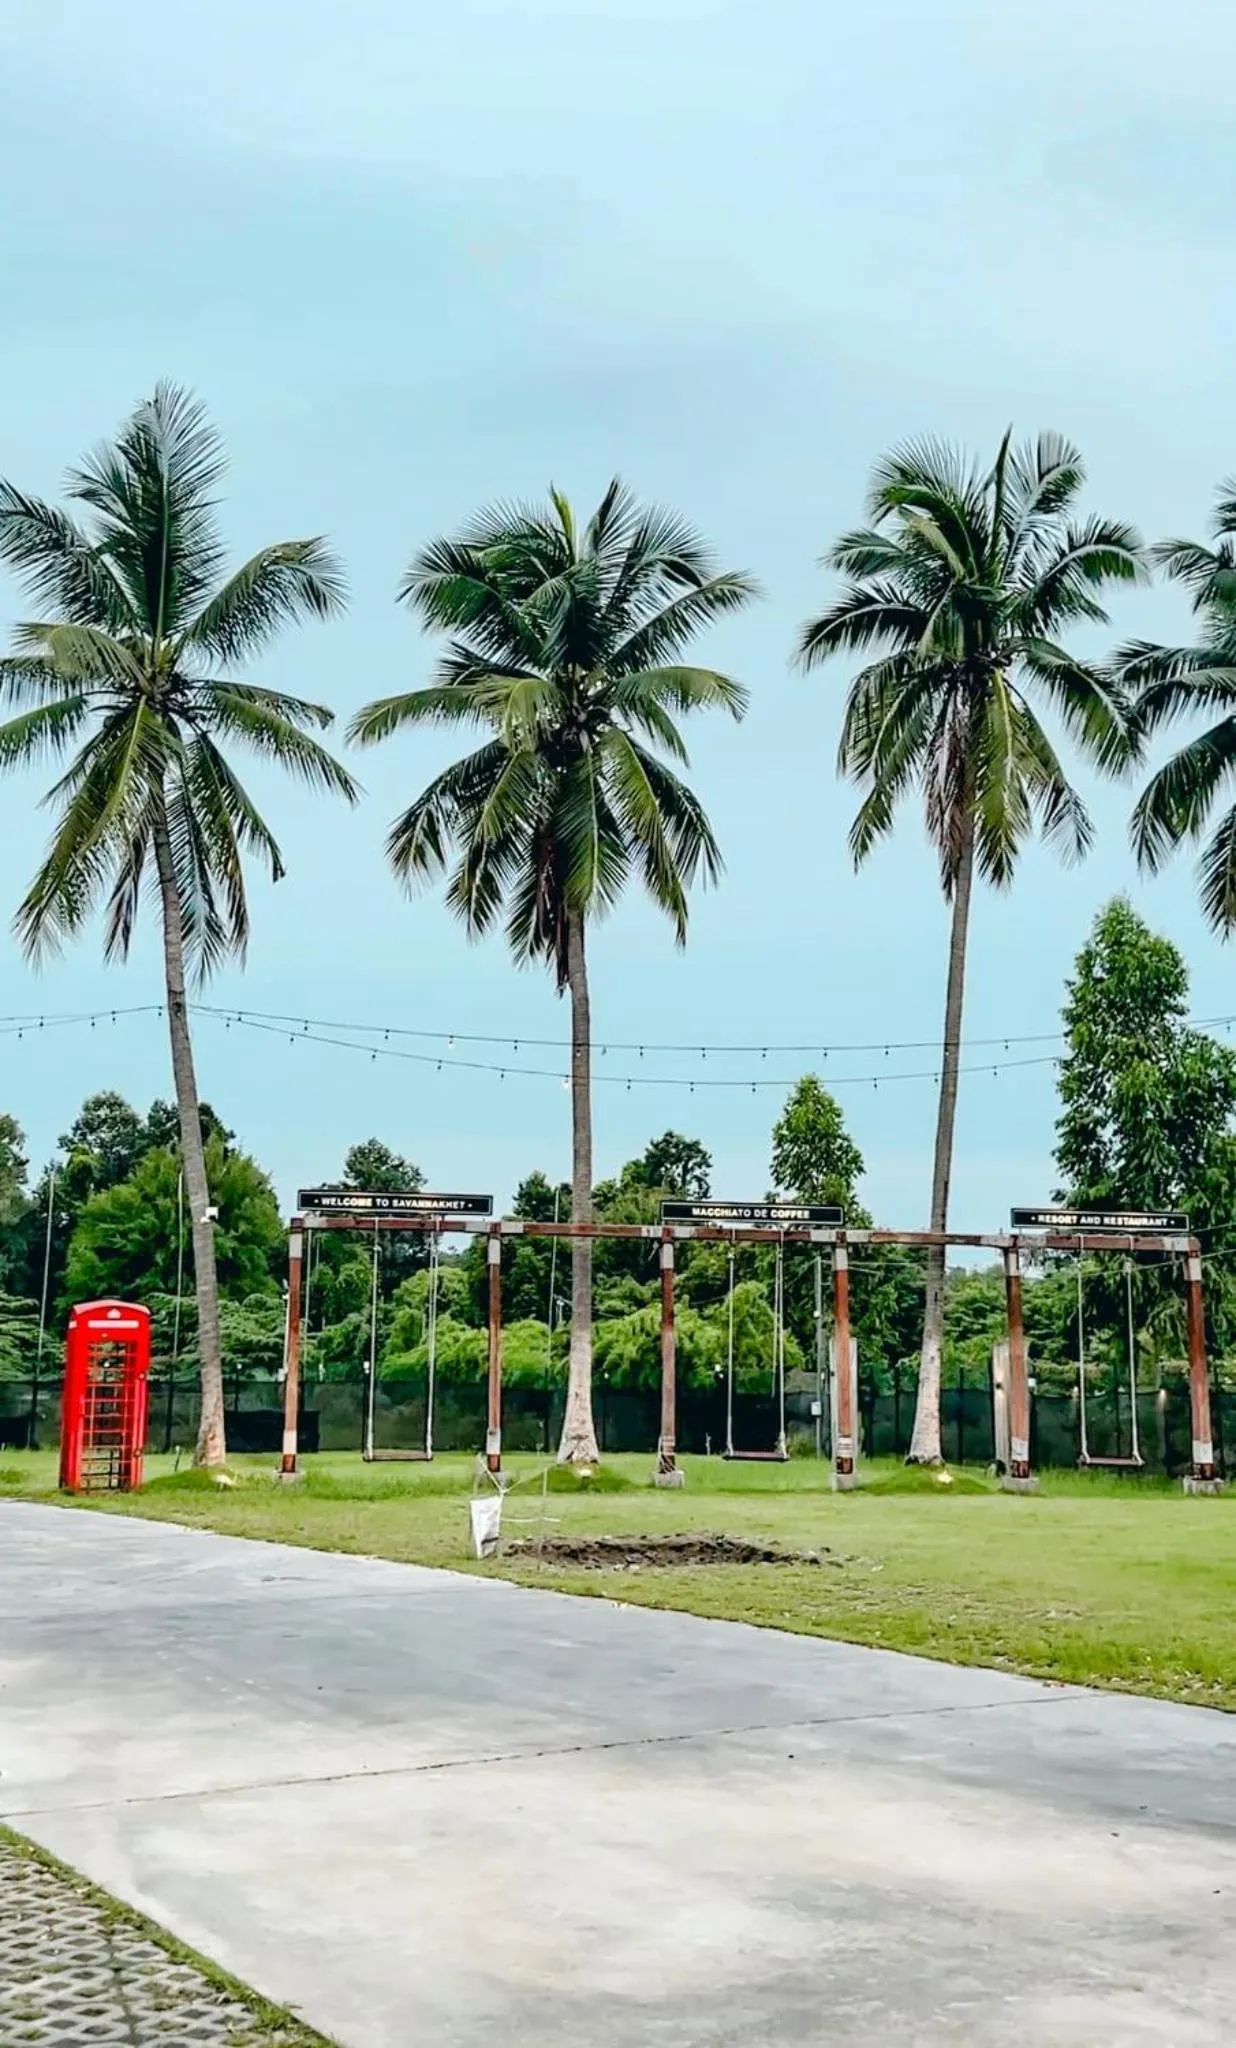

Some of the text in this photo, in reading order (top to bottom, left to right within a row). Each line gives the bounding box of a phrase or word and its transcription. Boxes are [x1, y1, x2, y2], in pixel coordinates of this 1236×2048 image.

[321, 1197, 466, 1209] WELCOME TO SAVANNAKHET
[692, 1207, 810, 1219] MACCHIATO DE COFFEE
[1038, 1214, 1168, 1226] RESORT AND RESTAURANT
